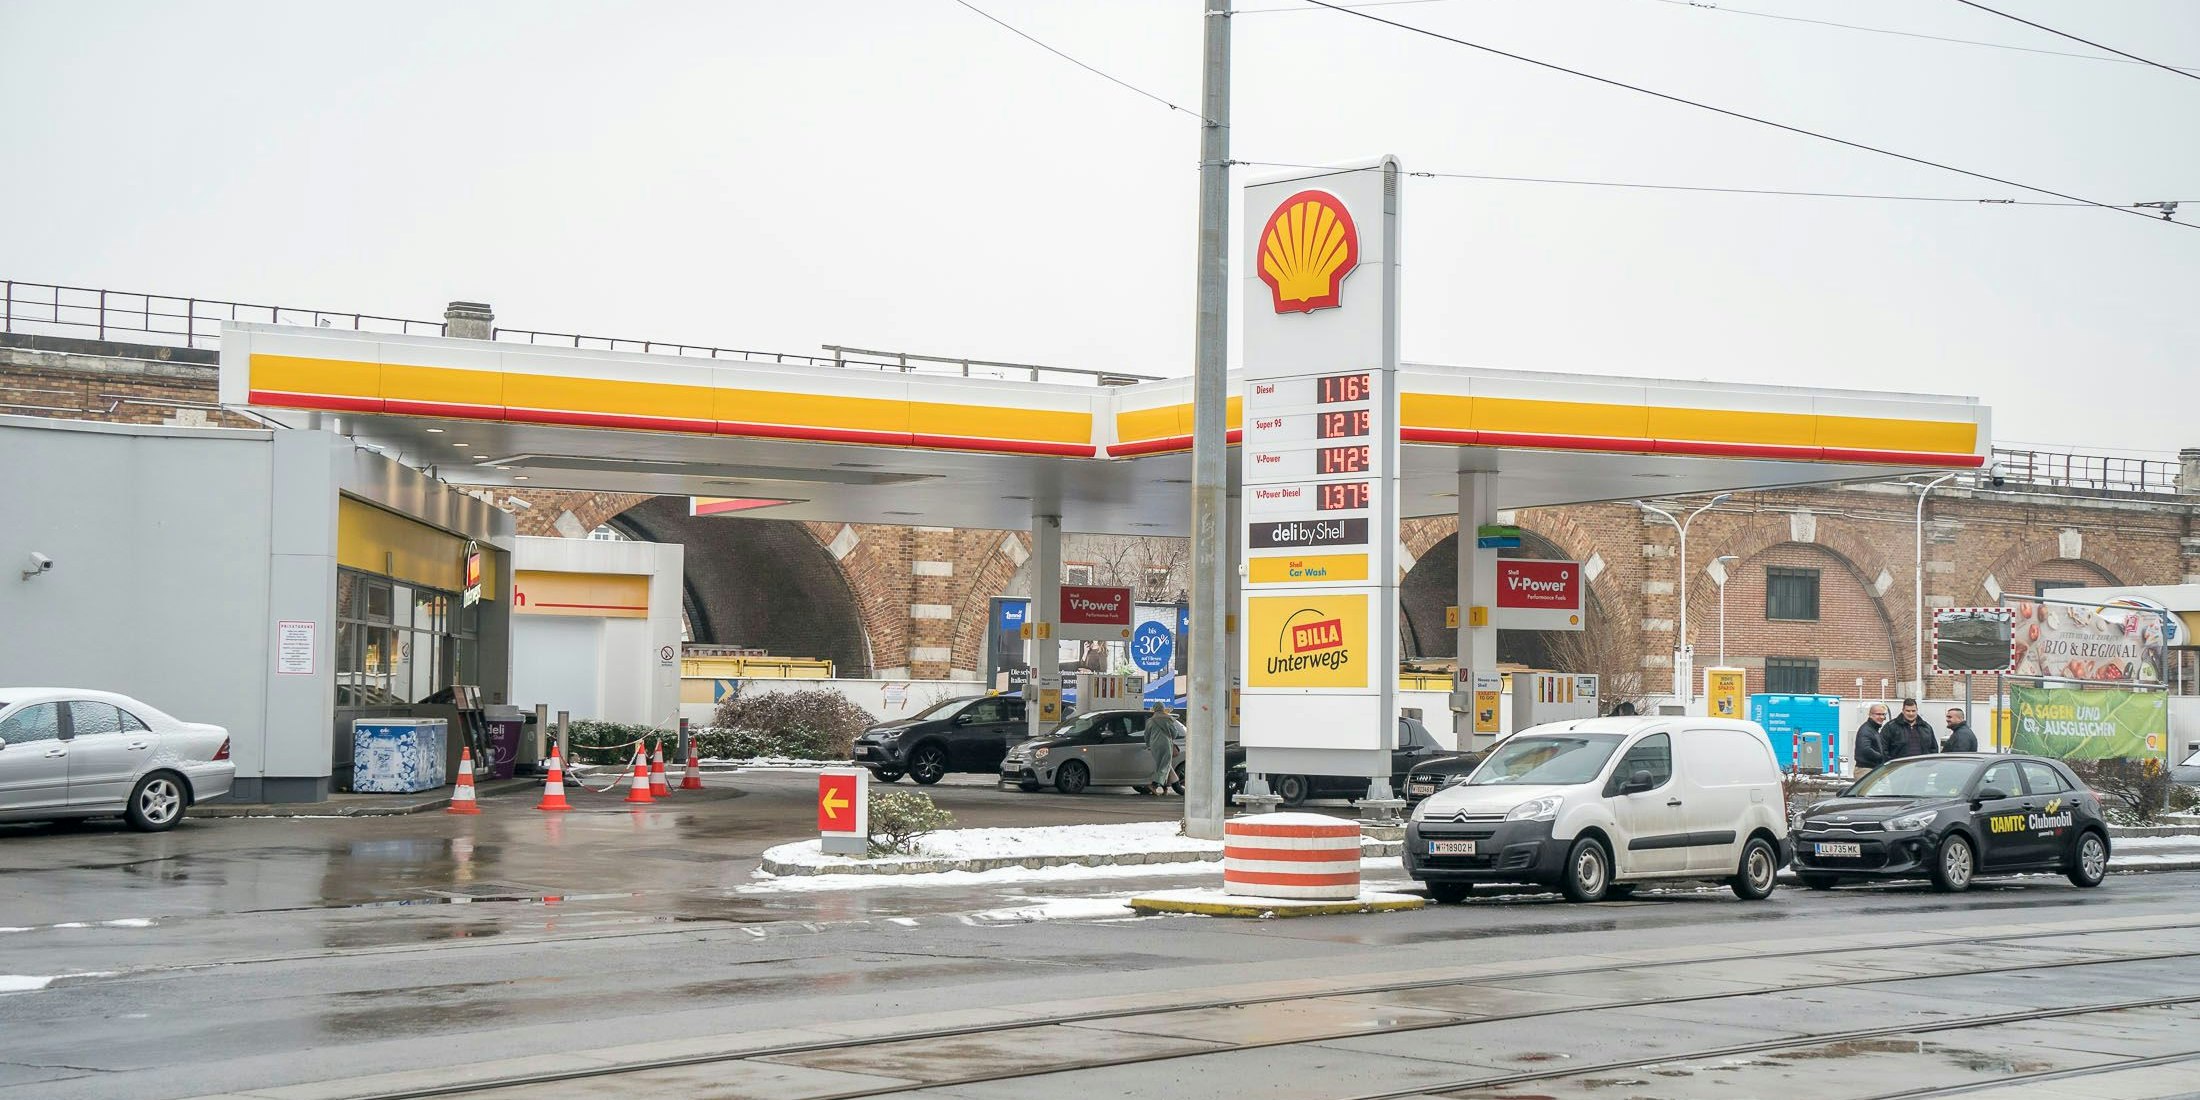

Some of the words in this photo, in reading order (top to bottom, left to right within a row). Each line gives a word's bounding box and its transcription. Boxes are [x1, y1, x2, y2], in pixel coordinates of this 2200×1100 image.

[1256, 384, 1274, 395] Diesel
[1325, 375, 1369, 403] 1.169
[1256, 420, 1273, 430] Super
[1274, 418, 1282, 428] 95
[1325, 411, 1369, 438] 1.219
[1256, 455, 1281, 464] V-Power
[1325, 447, 1369, 473] 1.429
[1256, 491, 1281, 499] V-Power
[1282, 488, 1301, 498] Diesel
[1325, 484, 1369, 510] 1.379
[1289, 569, 1302, 577] Car
[1304, 567, 1327, 577] Wash
[1508, 577, 1566, 592] V-Power
[1070, 599, 1119, 611] V-Power
[1296, 624, 1339, 648] BILLA
[2044, 640, 2067, 655] BIO
[2070, 643, 2079, 656] &
[2081, 643, 2137, 658] REGIONAL
[1267, 649, 1348, 674] Unterwegs
[2035, 705, 2074, 719] SAGEN
[2076, 706, 2100, 720] UND
[2043, 721, 2116, 736] AUSGLEICHEN
[1990, 815, 2025, 833] ÖAMTC
[2028, 811, 2073, 830] Clubmobil
[1436, 843, 1441, 852] W
[1821, 845, 1829, 853] LL
